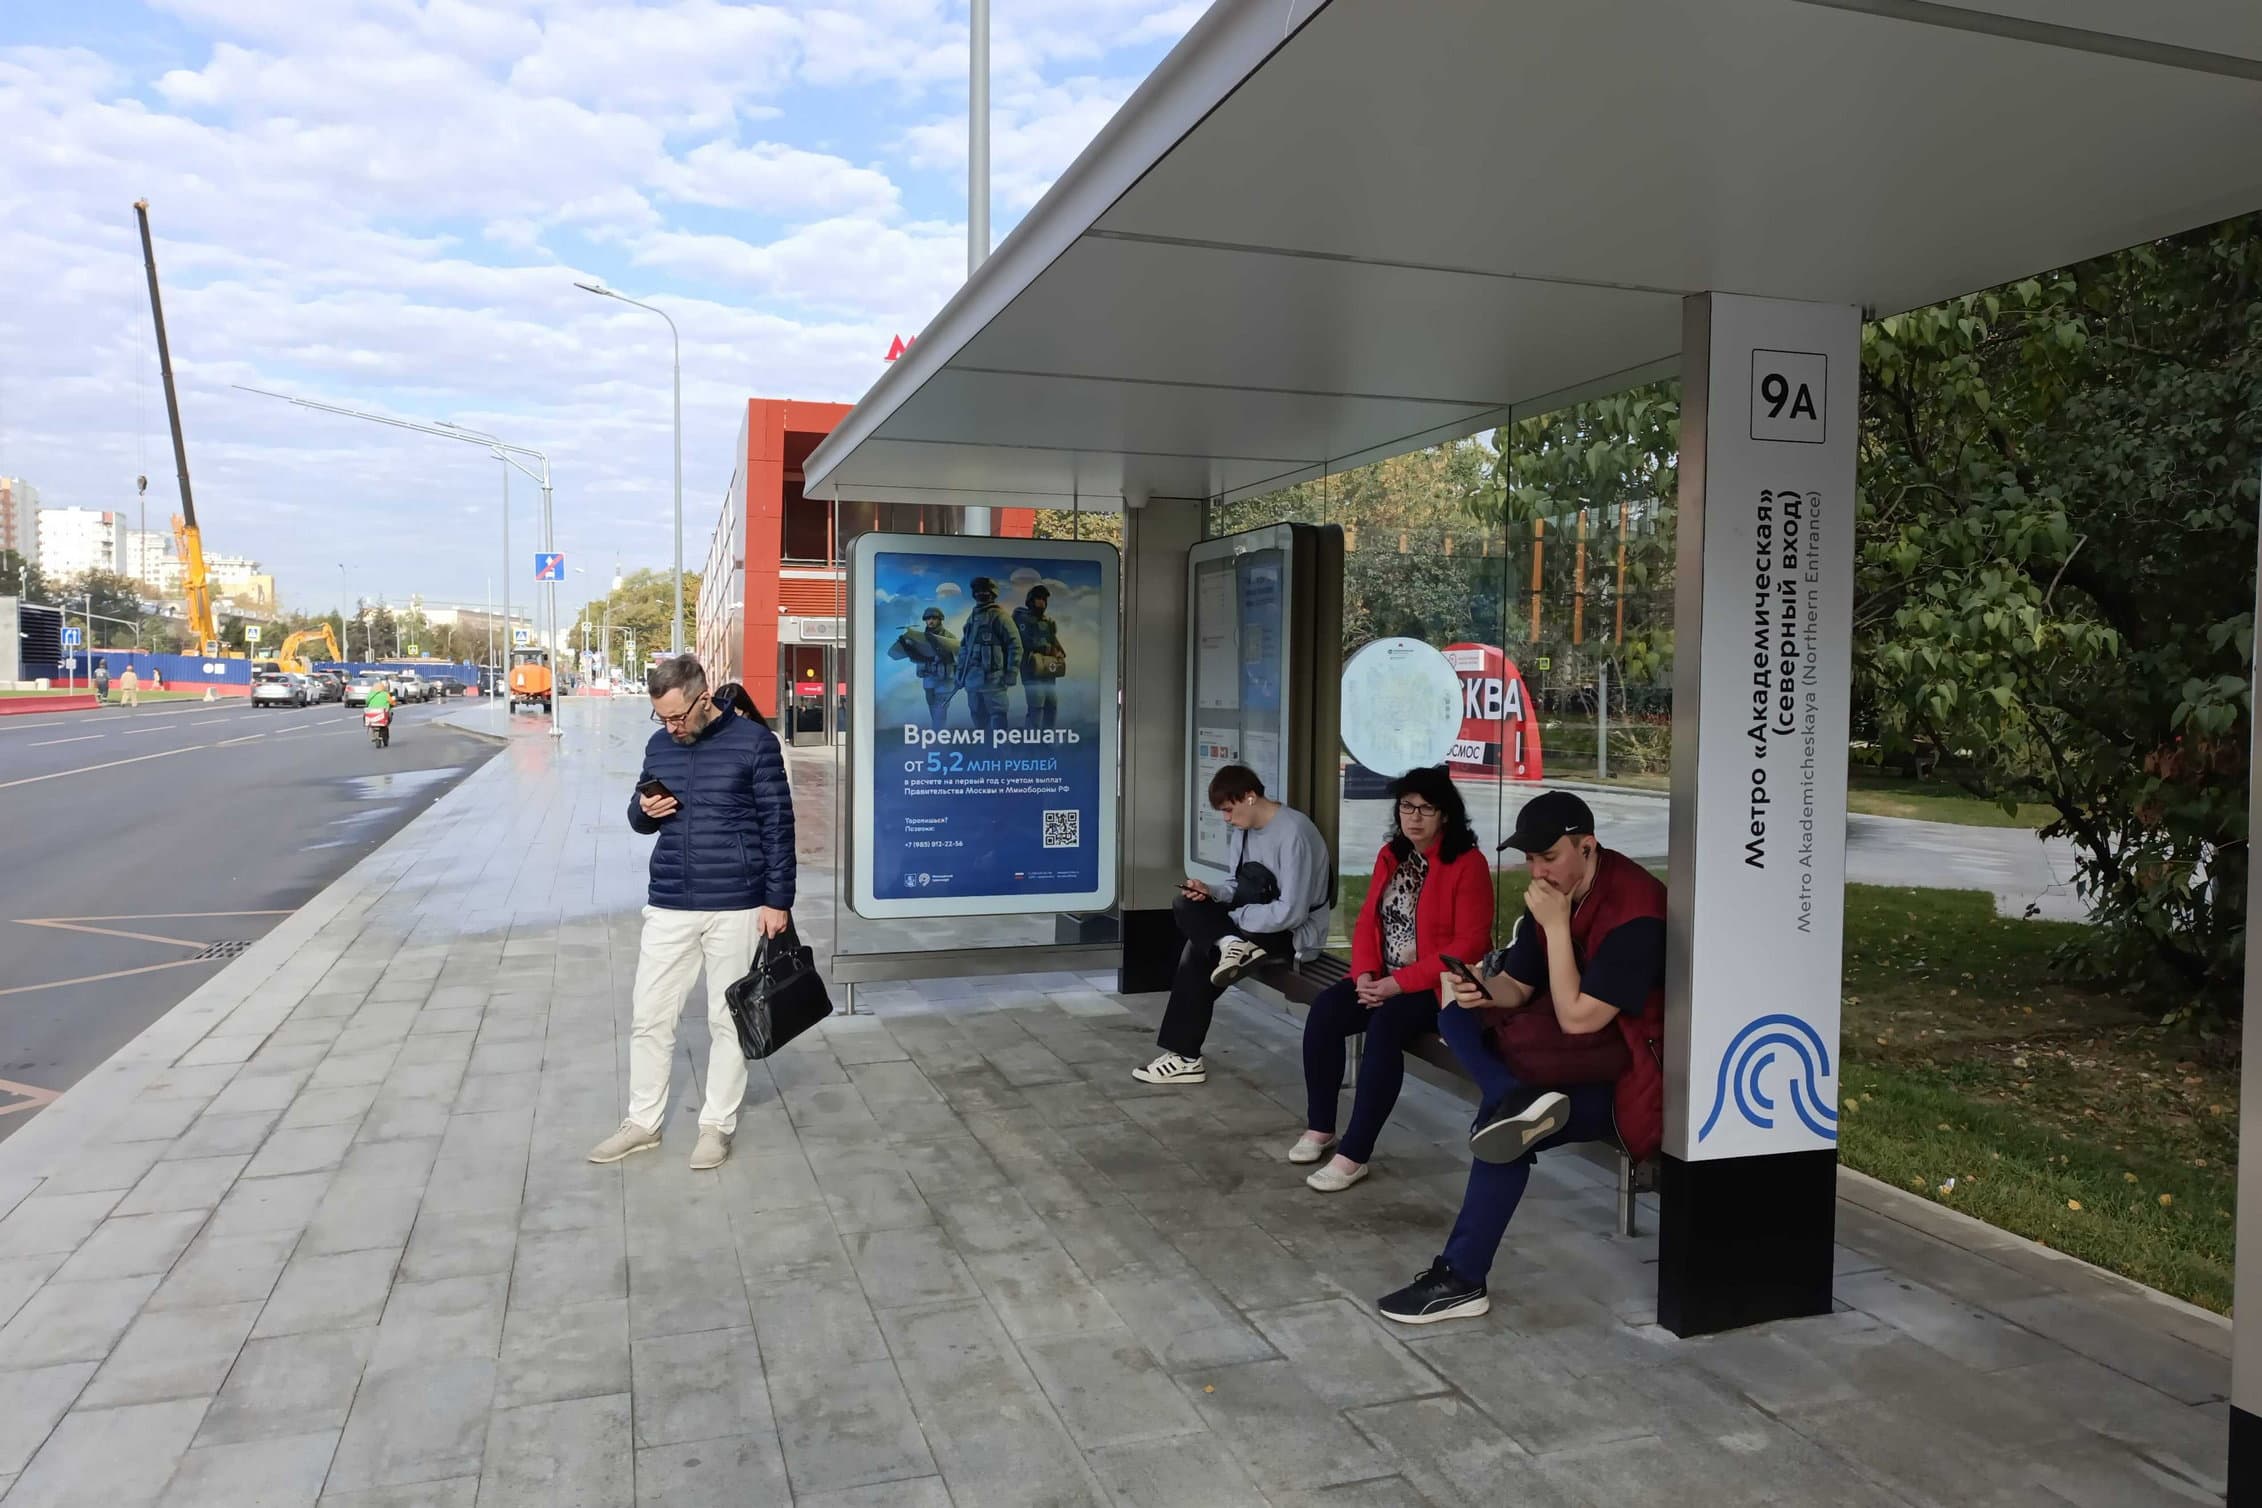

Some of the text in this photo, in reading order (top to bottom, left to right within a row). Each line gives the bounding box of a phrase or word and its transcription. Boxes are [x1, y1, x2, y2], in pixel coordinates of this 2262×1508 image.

[1761, 373, 1817, 420] 9А
[1771, 491, 1803, 735] (северный вход)
[1460, 678, 1522, 721] КВА
[1744, 489, 1773, 869] Метро «Академическая»
[1797, 491, 1822, 933] Metro Akademicheskaya (Northern Entrance)
[904, 724, 1080, 749] Время решать
[911, 779, 942, 787] расчете
[955, 777, 985, 785] первый
[1006, 778, 1034, 786] учетом
[927, 751, 964, 775] 5,2
[1004, 757, 1057, 771] РУБЛЕЙ
[904, 787, 964, 796] Правительства
[965, 787, 997, 795] Москвы
[1005, 786, 1056, 795] Минобороны
[1058, 785, 1070, 793] РФ
